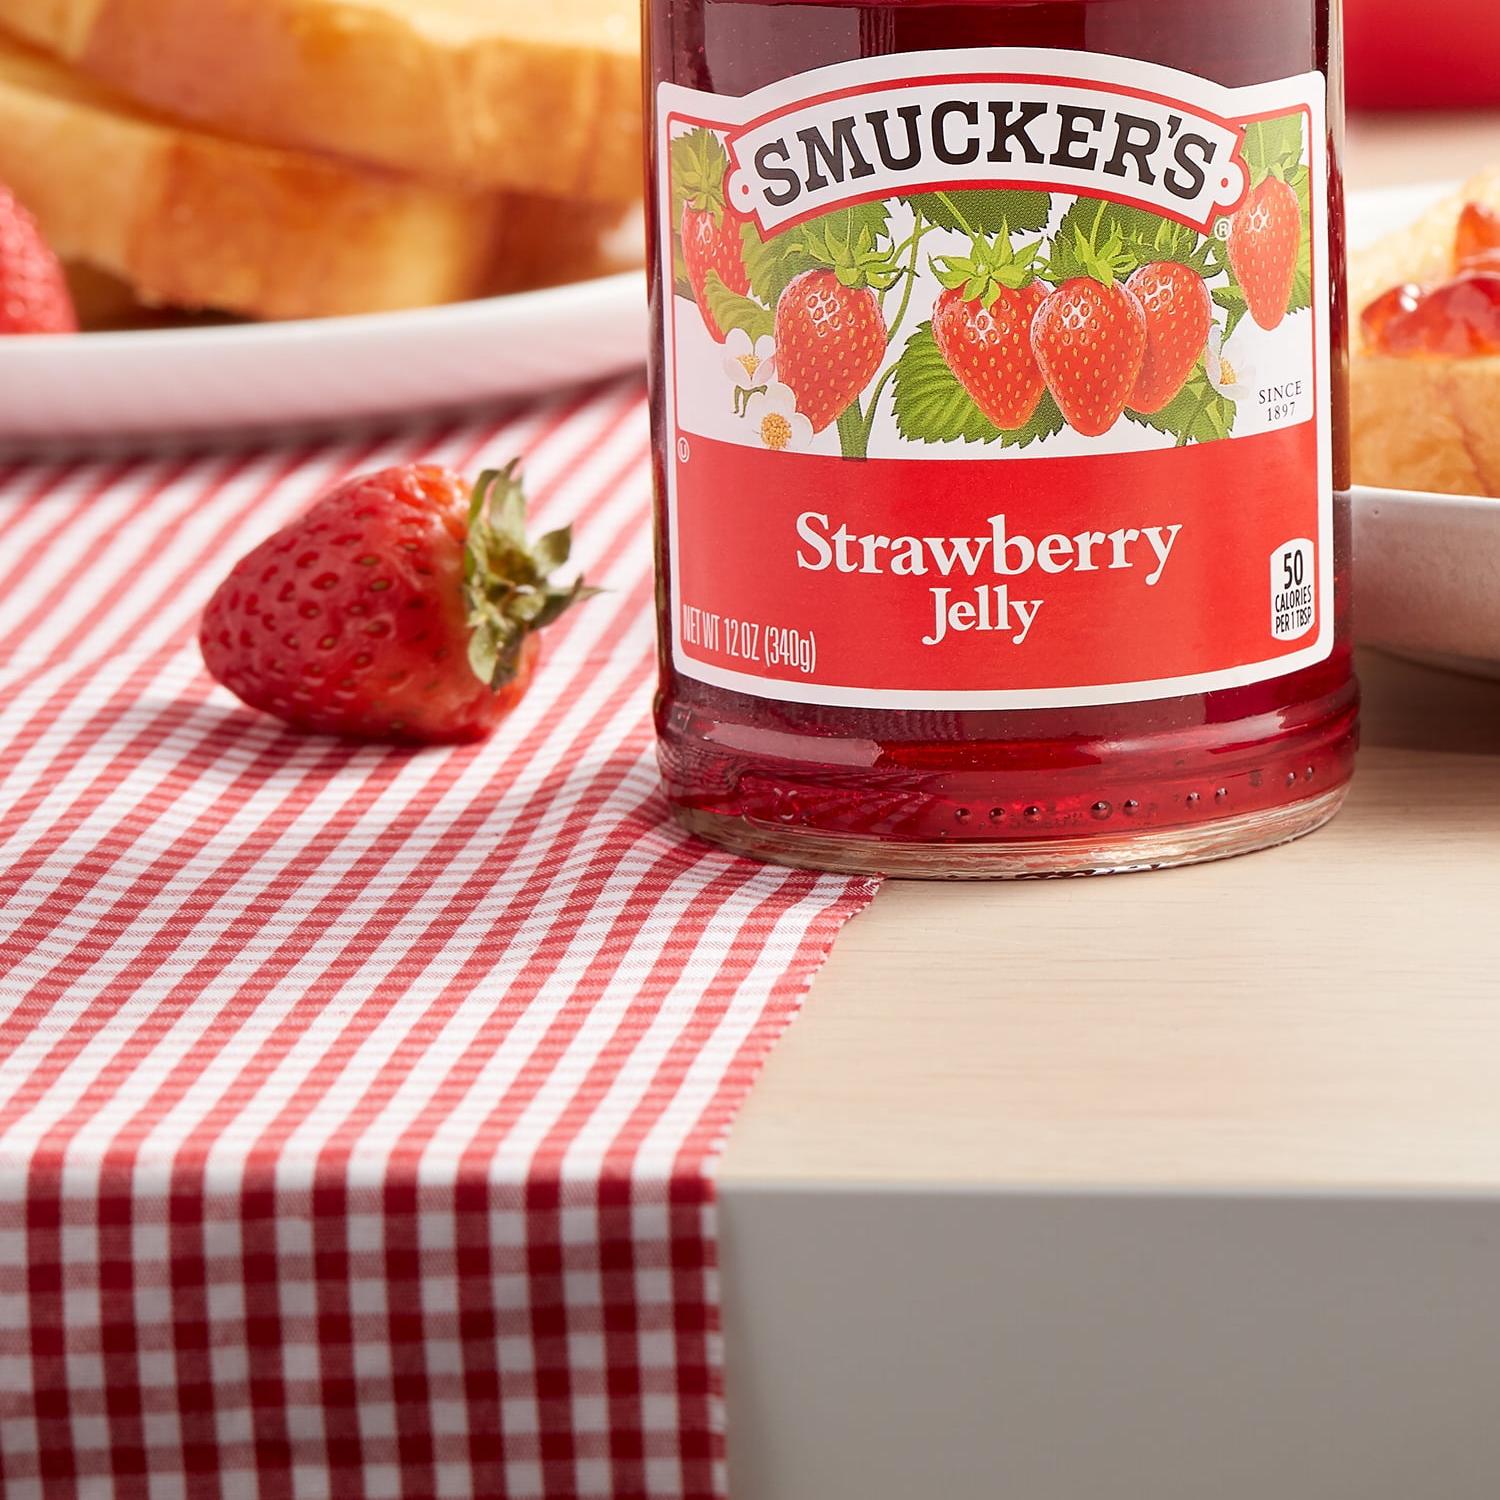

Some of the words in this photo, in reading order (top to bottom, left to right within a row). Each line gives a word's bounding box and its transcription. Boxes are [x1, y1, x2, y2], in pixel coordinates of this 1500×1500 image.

[753, 100, 1218, 207] SMUCKER'S
[1258, 380, 1302, 405] SINCE
[1267, 401, 1296, 422] 1897
[795, 511, 1183, 586] Strawberry
[1283, 549, 1304, 590] 50
[921, 584, 1044, 645] Jelly
[1274, 584, 1312, 613] CALORIES
[683, 604, 701, 646] NET
[702, 611, 720, 652] WT
[723, 618, 740, 657] 12
[741, 621, 760, 661] OZ
[764, 625, 816, 674] (340g)
[1275, 613, 1290, 635] PER
[1296, 606, 1312, 629] TBSP
